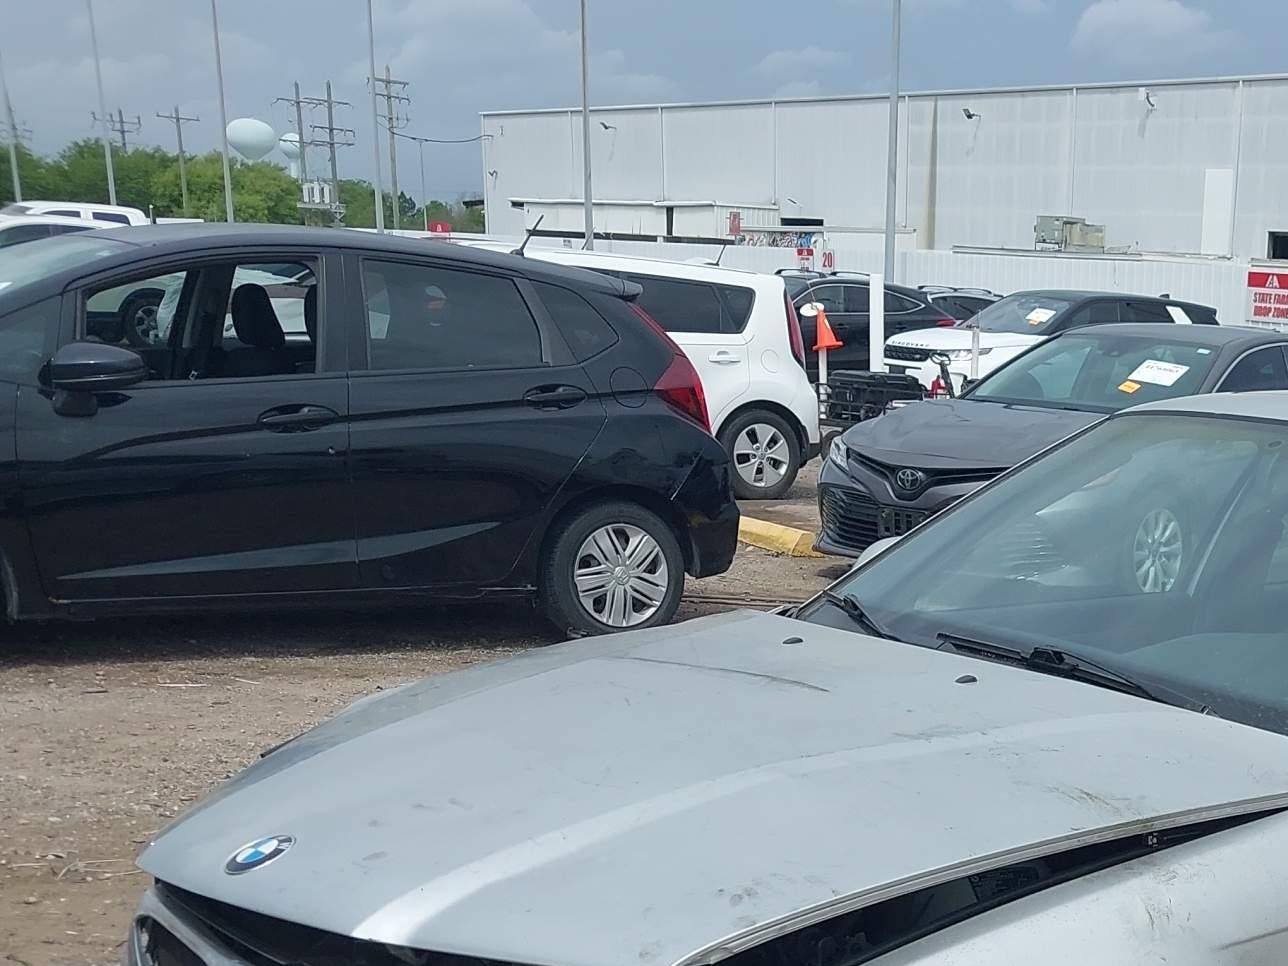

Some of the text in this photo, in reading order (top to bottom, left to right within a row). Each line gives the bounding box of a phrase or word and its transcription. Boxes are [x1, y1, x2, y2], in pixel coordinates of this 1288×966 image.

[822, 251, 833, 268] 20
[1252, 292, 1273, 304] STATE
[1253, 305, 1273, 317] DROP
